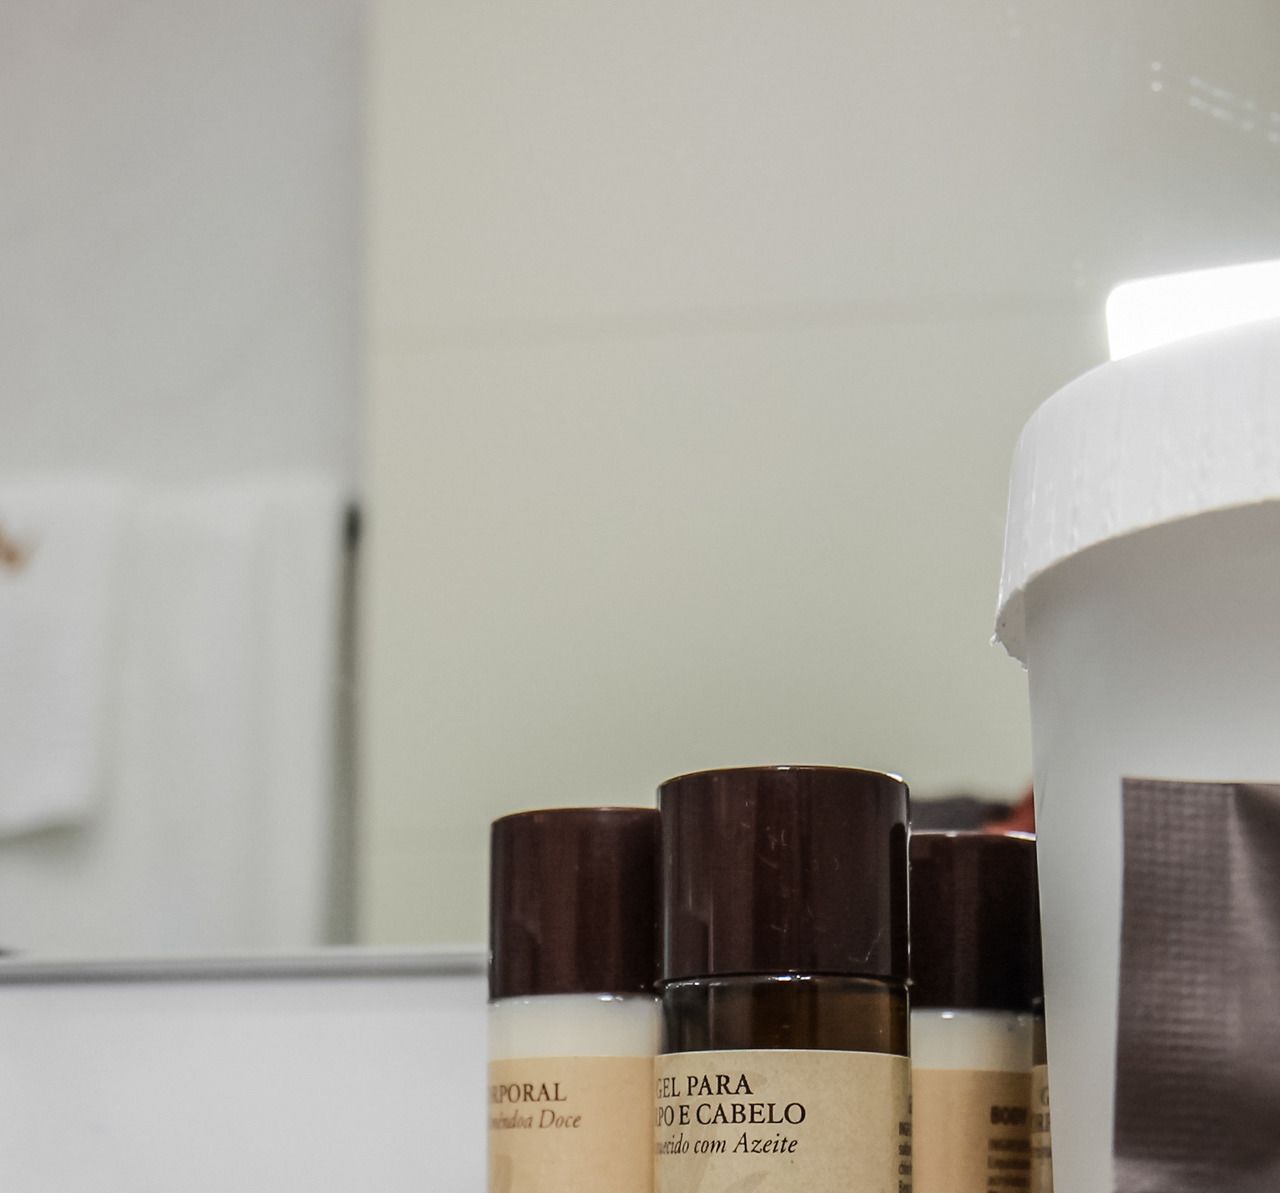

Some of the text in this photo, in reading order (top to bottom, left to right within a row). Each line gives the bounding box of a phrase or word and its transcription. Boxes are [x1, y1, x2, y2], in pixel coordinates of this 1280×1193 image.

[687, 1074, 753, 1096] PARA
[539, 1108, 581, 1129] Doce
[679, 1105, 690, 1125] E
[696, 1103, 806, 1125] CABELO
[694, 1139, 726, 1153] com
[733, 1132, 797, 1153] Azeite
